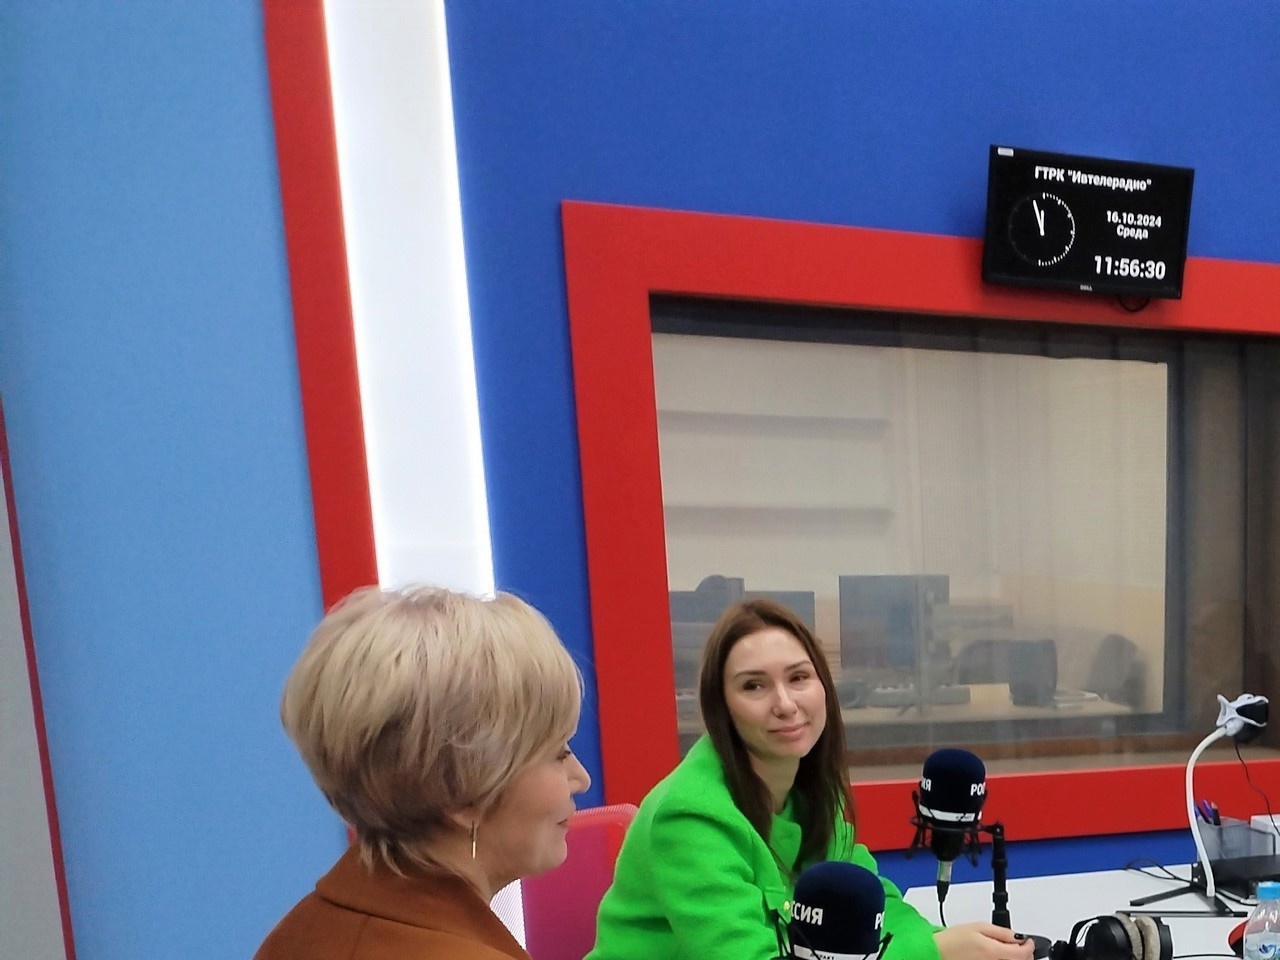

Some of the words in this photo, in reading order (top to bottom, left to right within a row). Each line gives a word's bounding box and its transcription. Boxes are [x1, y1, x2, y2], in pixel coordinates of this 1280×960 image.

[1034, 165, 1065, 183] ГТРК
[1067, 169, 1152, 192] "Ивтелерадио"
[1106, 210, 1162, 228] 16.10.2024
[1116, 226, 1149, 240] Среда
[1094, 255, 1166, 280] 11:56:30
